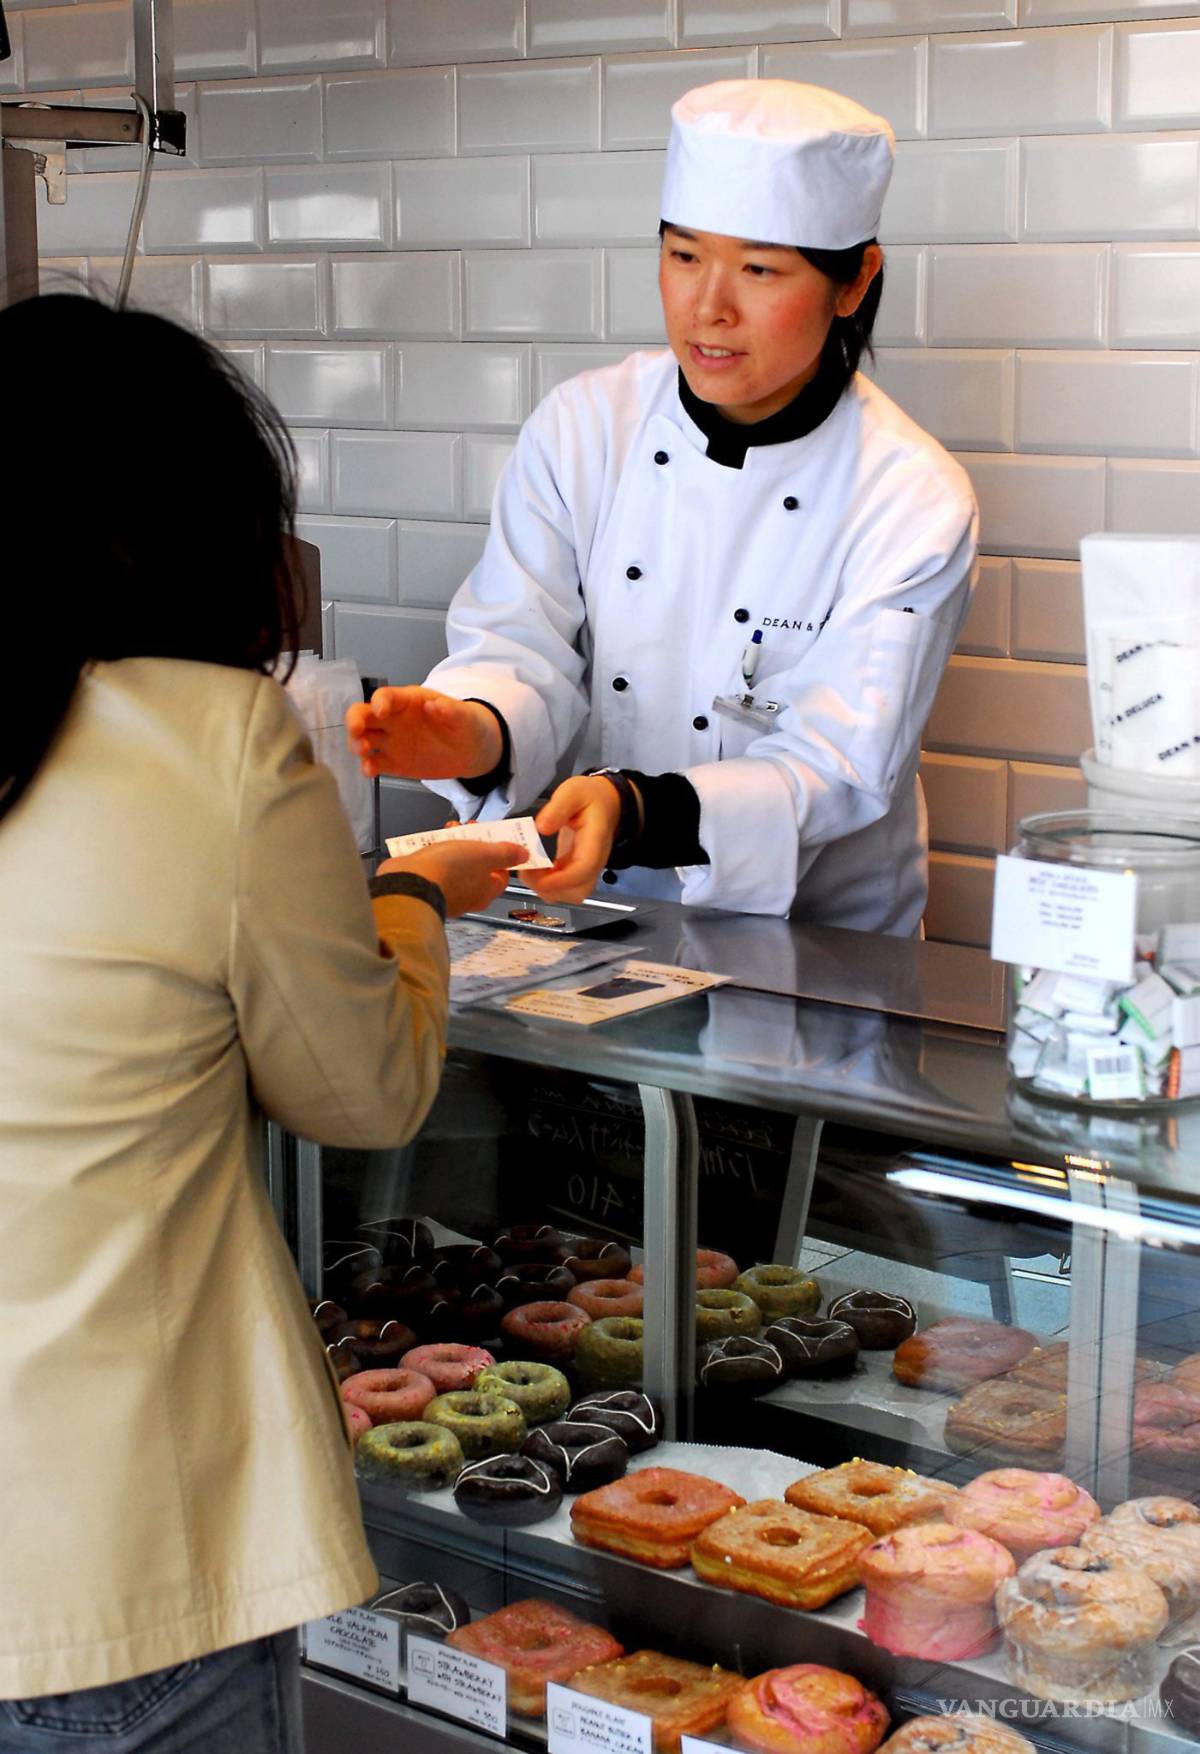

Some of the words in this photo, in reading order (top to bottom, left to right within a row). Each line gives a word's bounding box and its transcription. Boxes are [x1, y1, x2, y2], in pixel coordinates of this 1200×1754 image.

[762, 617, 802, 630] DEAN
[806, 622, 813, 631] &
[1116, 645, 1142, 663] DEAN
[1158, 742, 1190, 761] DEAN
[329, 1625, 377, 1648] CHOCOLATE
